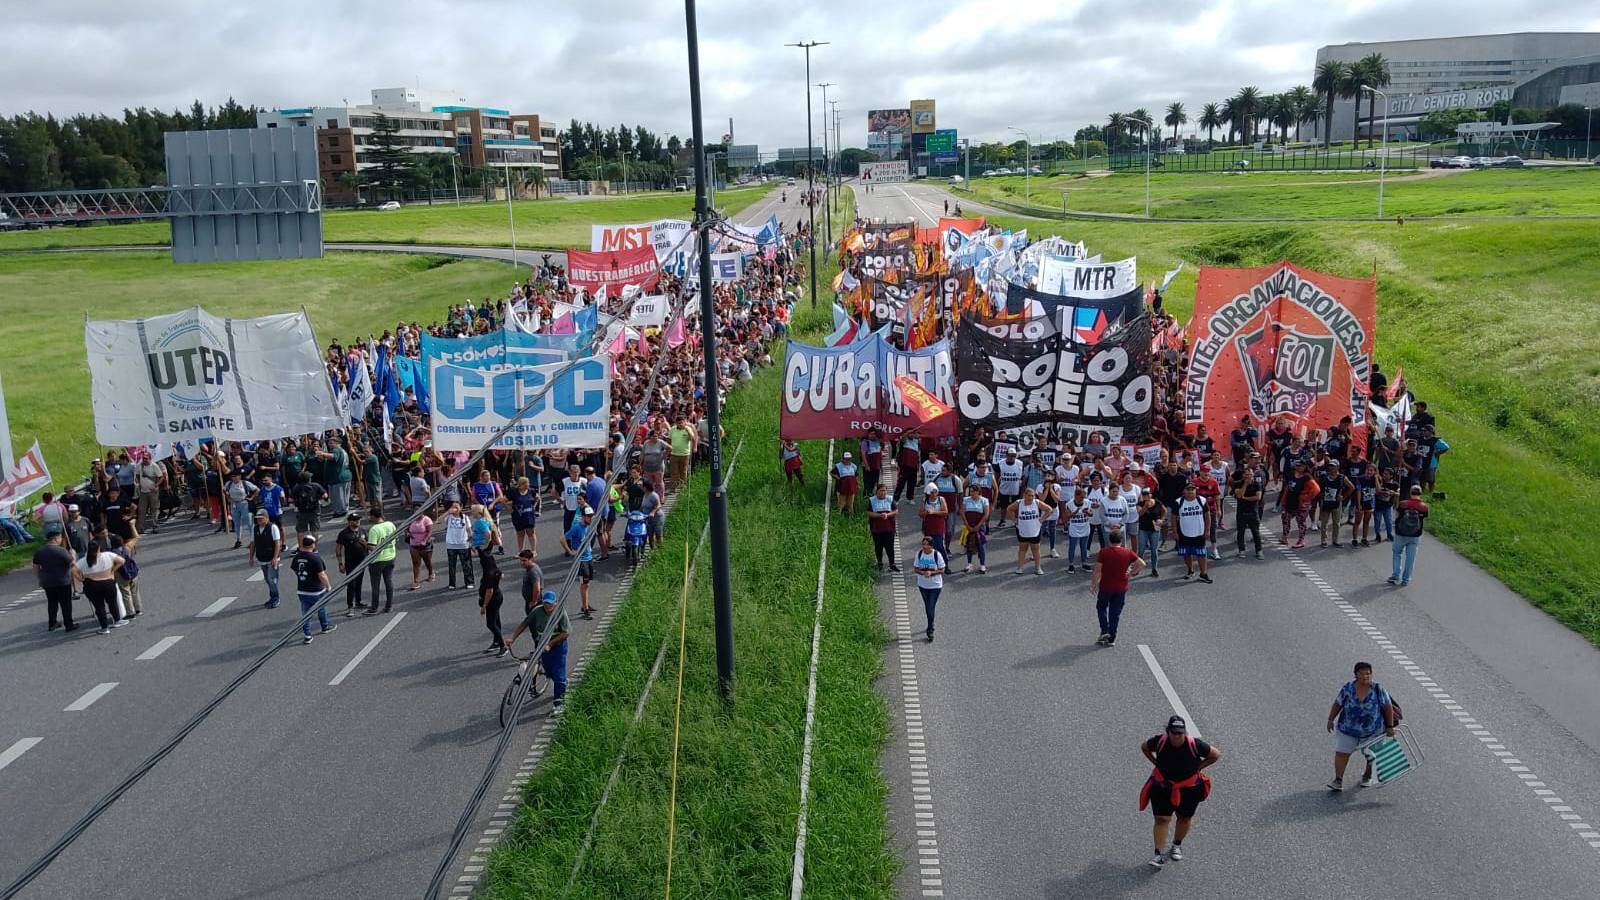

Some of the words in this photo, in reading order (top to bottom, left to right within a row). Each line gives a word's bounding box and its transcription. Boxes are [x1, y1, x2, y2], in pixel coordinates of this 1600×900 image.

[1391, 96, 1415, 113] CITY
[1423, 92, 1466, 109] CENTER
[601, 226, 652, 251] MST
[570, 259, 658, 282] NUESTRAMÉRICA
[1073, 266, 1117, 291] MTR
[147, 346, 230, 390] UTEP
[988, 346, 1129, 387] POLO
[1276, 337, 1323, 384] FOL
[434, 360, 604, 420] CCC
[959, 375, 1151, 419] OBRERO
[170, 416, 215, 433] SANTA
[219, 418, 234, 431] FE
[437, 425, 486, 434] CORRIENTE
[551, 422, 604, 431] COMBATIVA
[494, 434, 559, 447] ROSARIO
